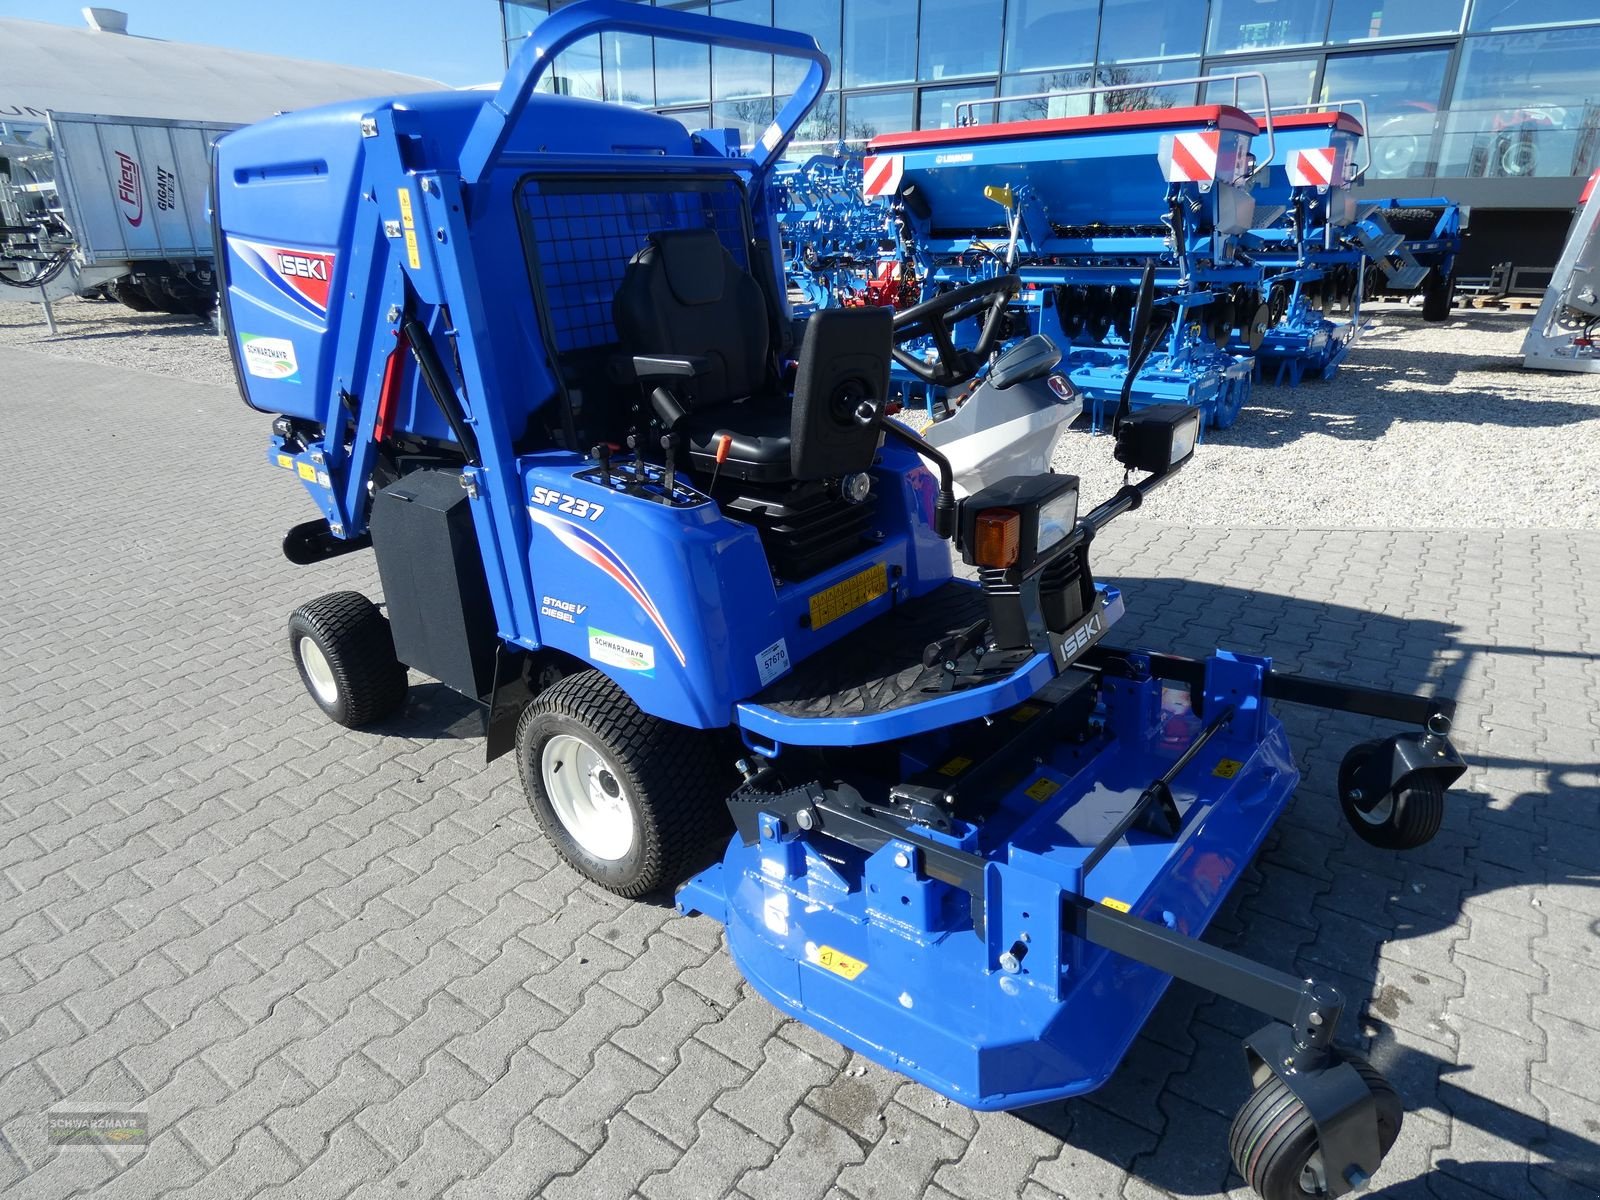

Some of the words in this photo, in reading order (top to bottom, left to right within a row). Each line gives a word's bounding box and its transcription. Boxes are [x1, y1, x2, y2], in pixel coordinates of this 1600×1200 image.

[157, 165, 168, 211] GIGANT
[277, 253, 328, 282] ISEKI
[541, 605, 576, 624] DIESEL
[542, 595, 577, 613] STAGE
[575, 603, 587, 615] V
[594, 637, 644, 659] SCHWARZMAYR
[1060, 613, 1102, 662] ISEKI
[764, 649, 785, 669] 57670
